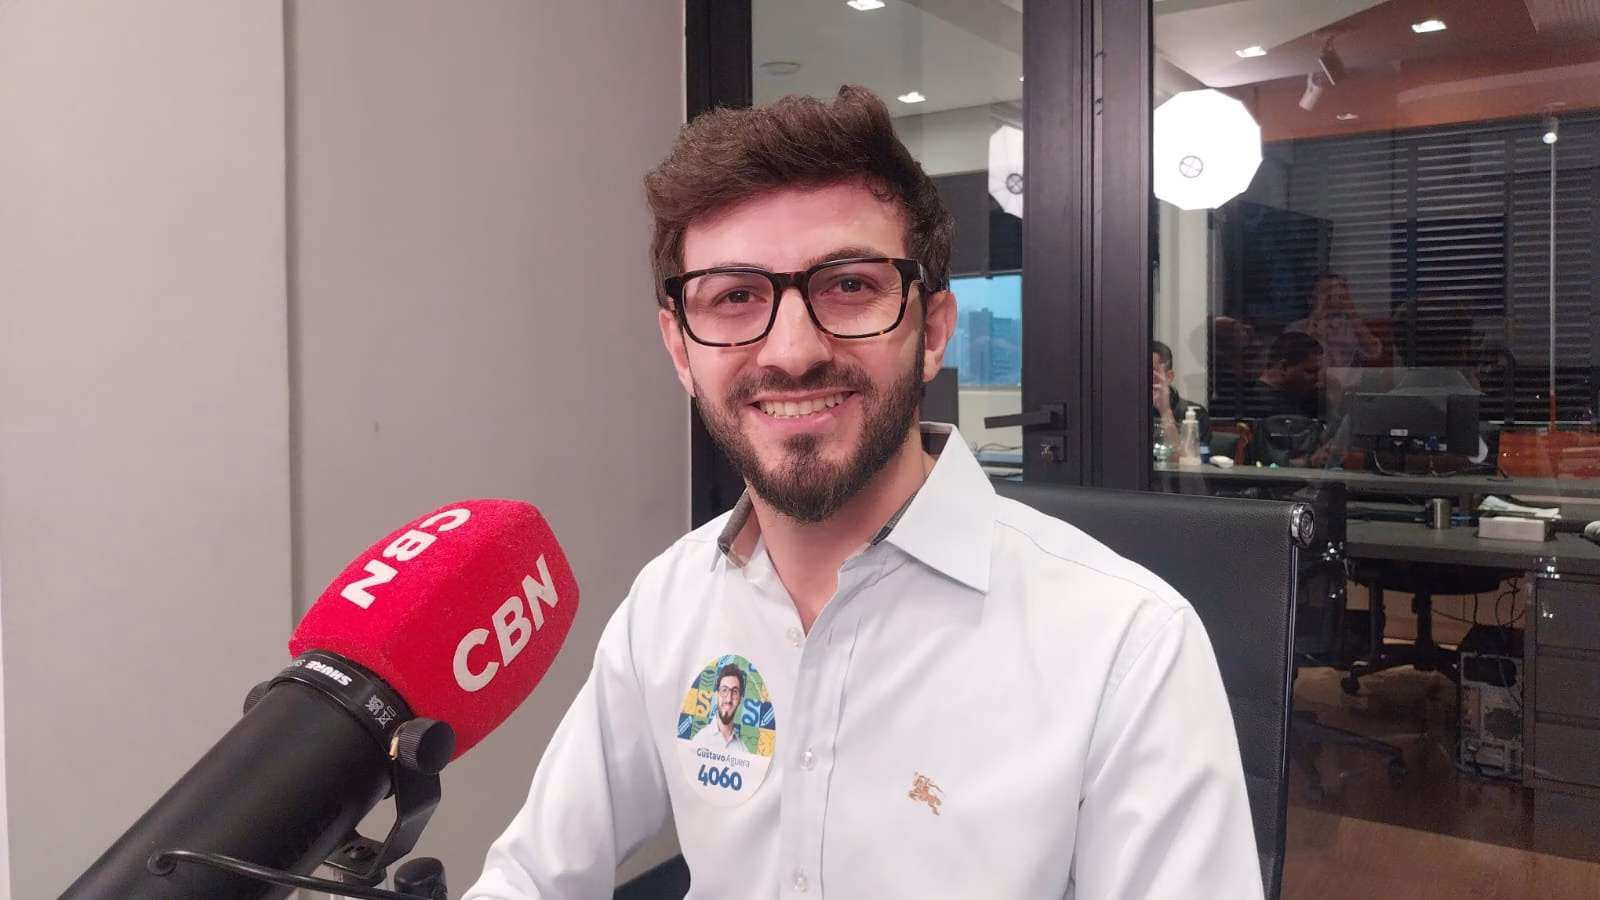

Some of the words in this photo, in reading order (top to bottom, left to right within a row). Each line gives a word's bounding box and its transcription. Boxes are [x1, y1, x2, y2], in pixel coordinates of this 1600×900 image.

[340, 508, 471, 610] CBN
[452, 553, 559, 692] CBN
[305, 660, 353, 686] SHURE
[696, 748, 726, 762] Gustavo
[698, 764, 742, 790] 4060
